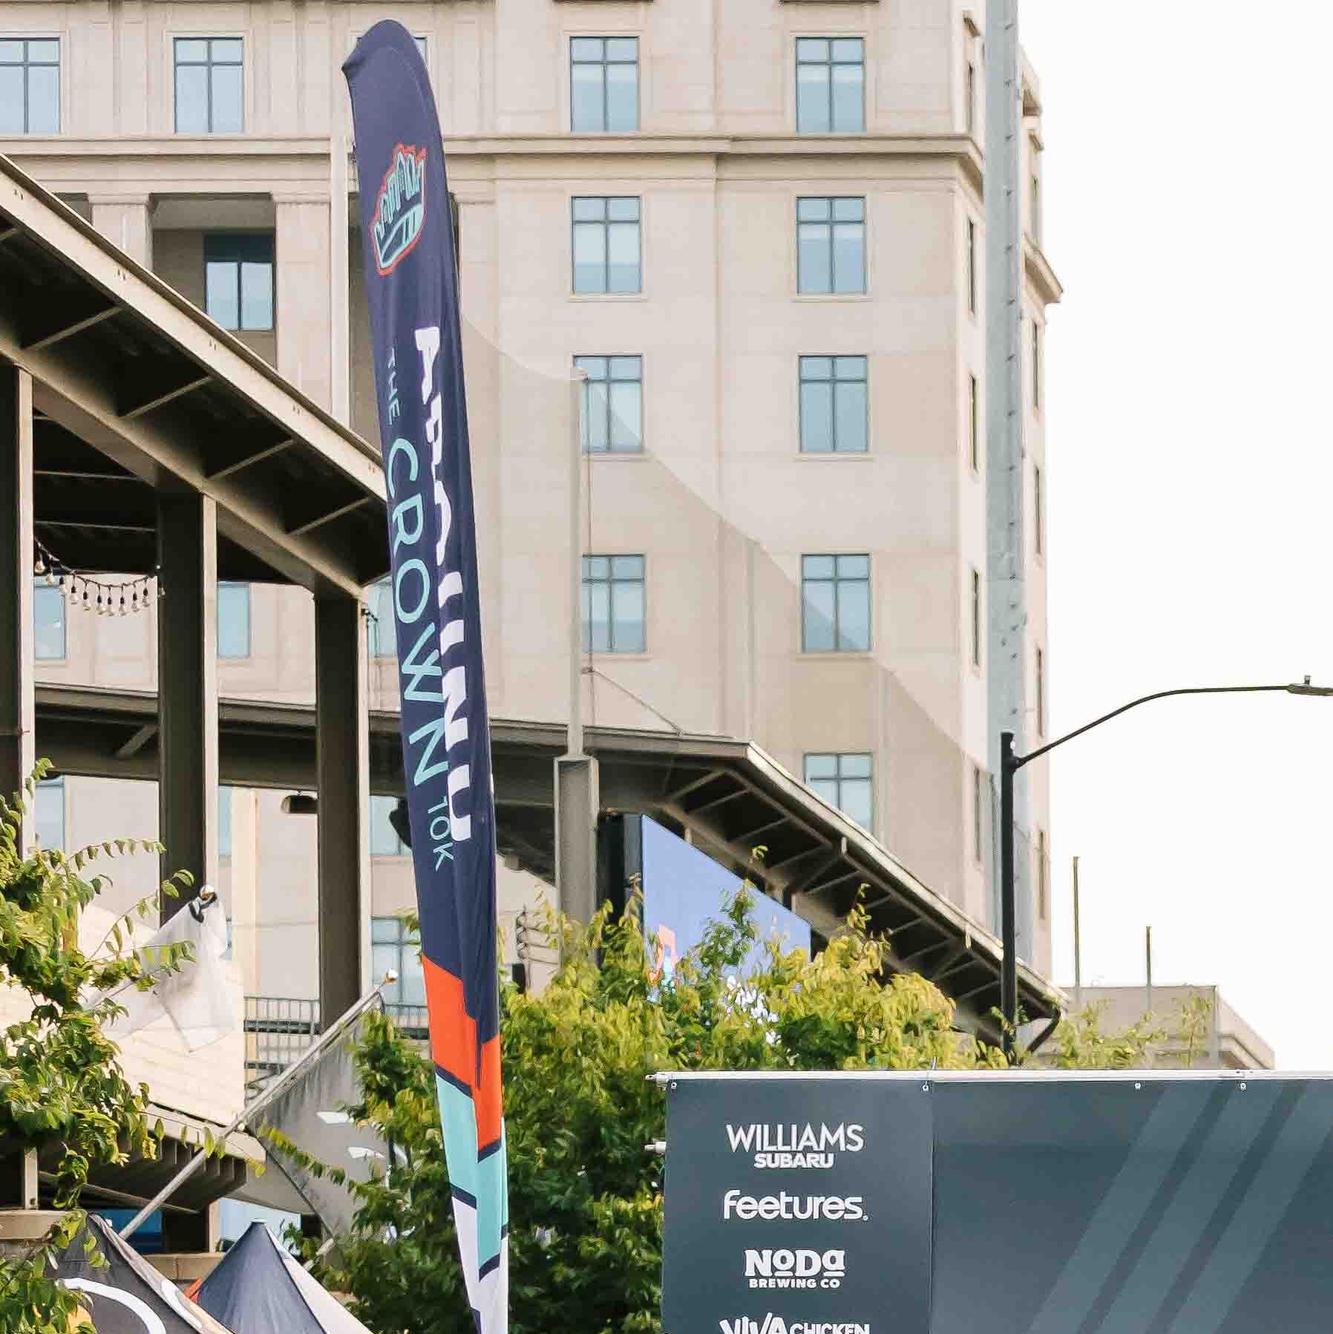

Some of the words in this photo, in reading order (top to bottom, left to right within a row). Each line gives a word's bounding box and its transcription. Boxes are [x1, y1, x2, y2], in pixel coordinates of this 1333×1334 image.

[384, 346, 402, 425] THE
[384, 437, 448, 787] CROWN
[420, 793, 453, 873] 10K
[727, 1122, 865, 1153] WILLIAMS
[754, 1153, 834, 1169] SUBARU
[749, 1278, 817, 1289] BREWING
[820, 1278, 841, 1289] CO
